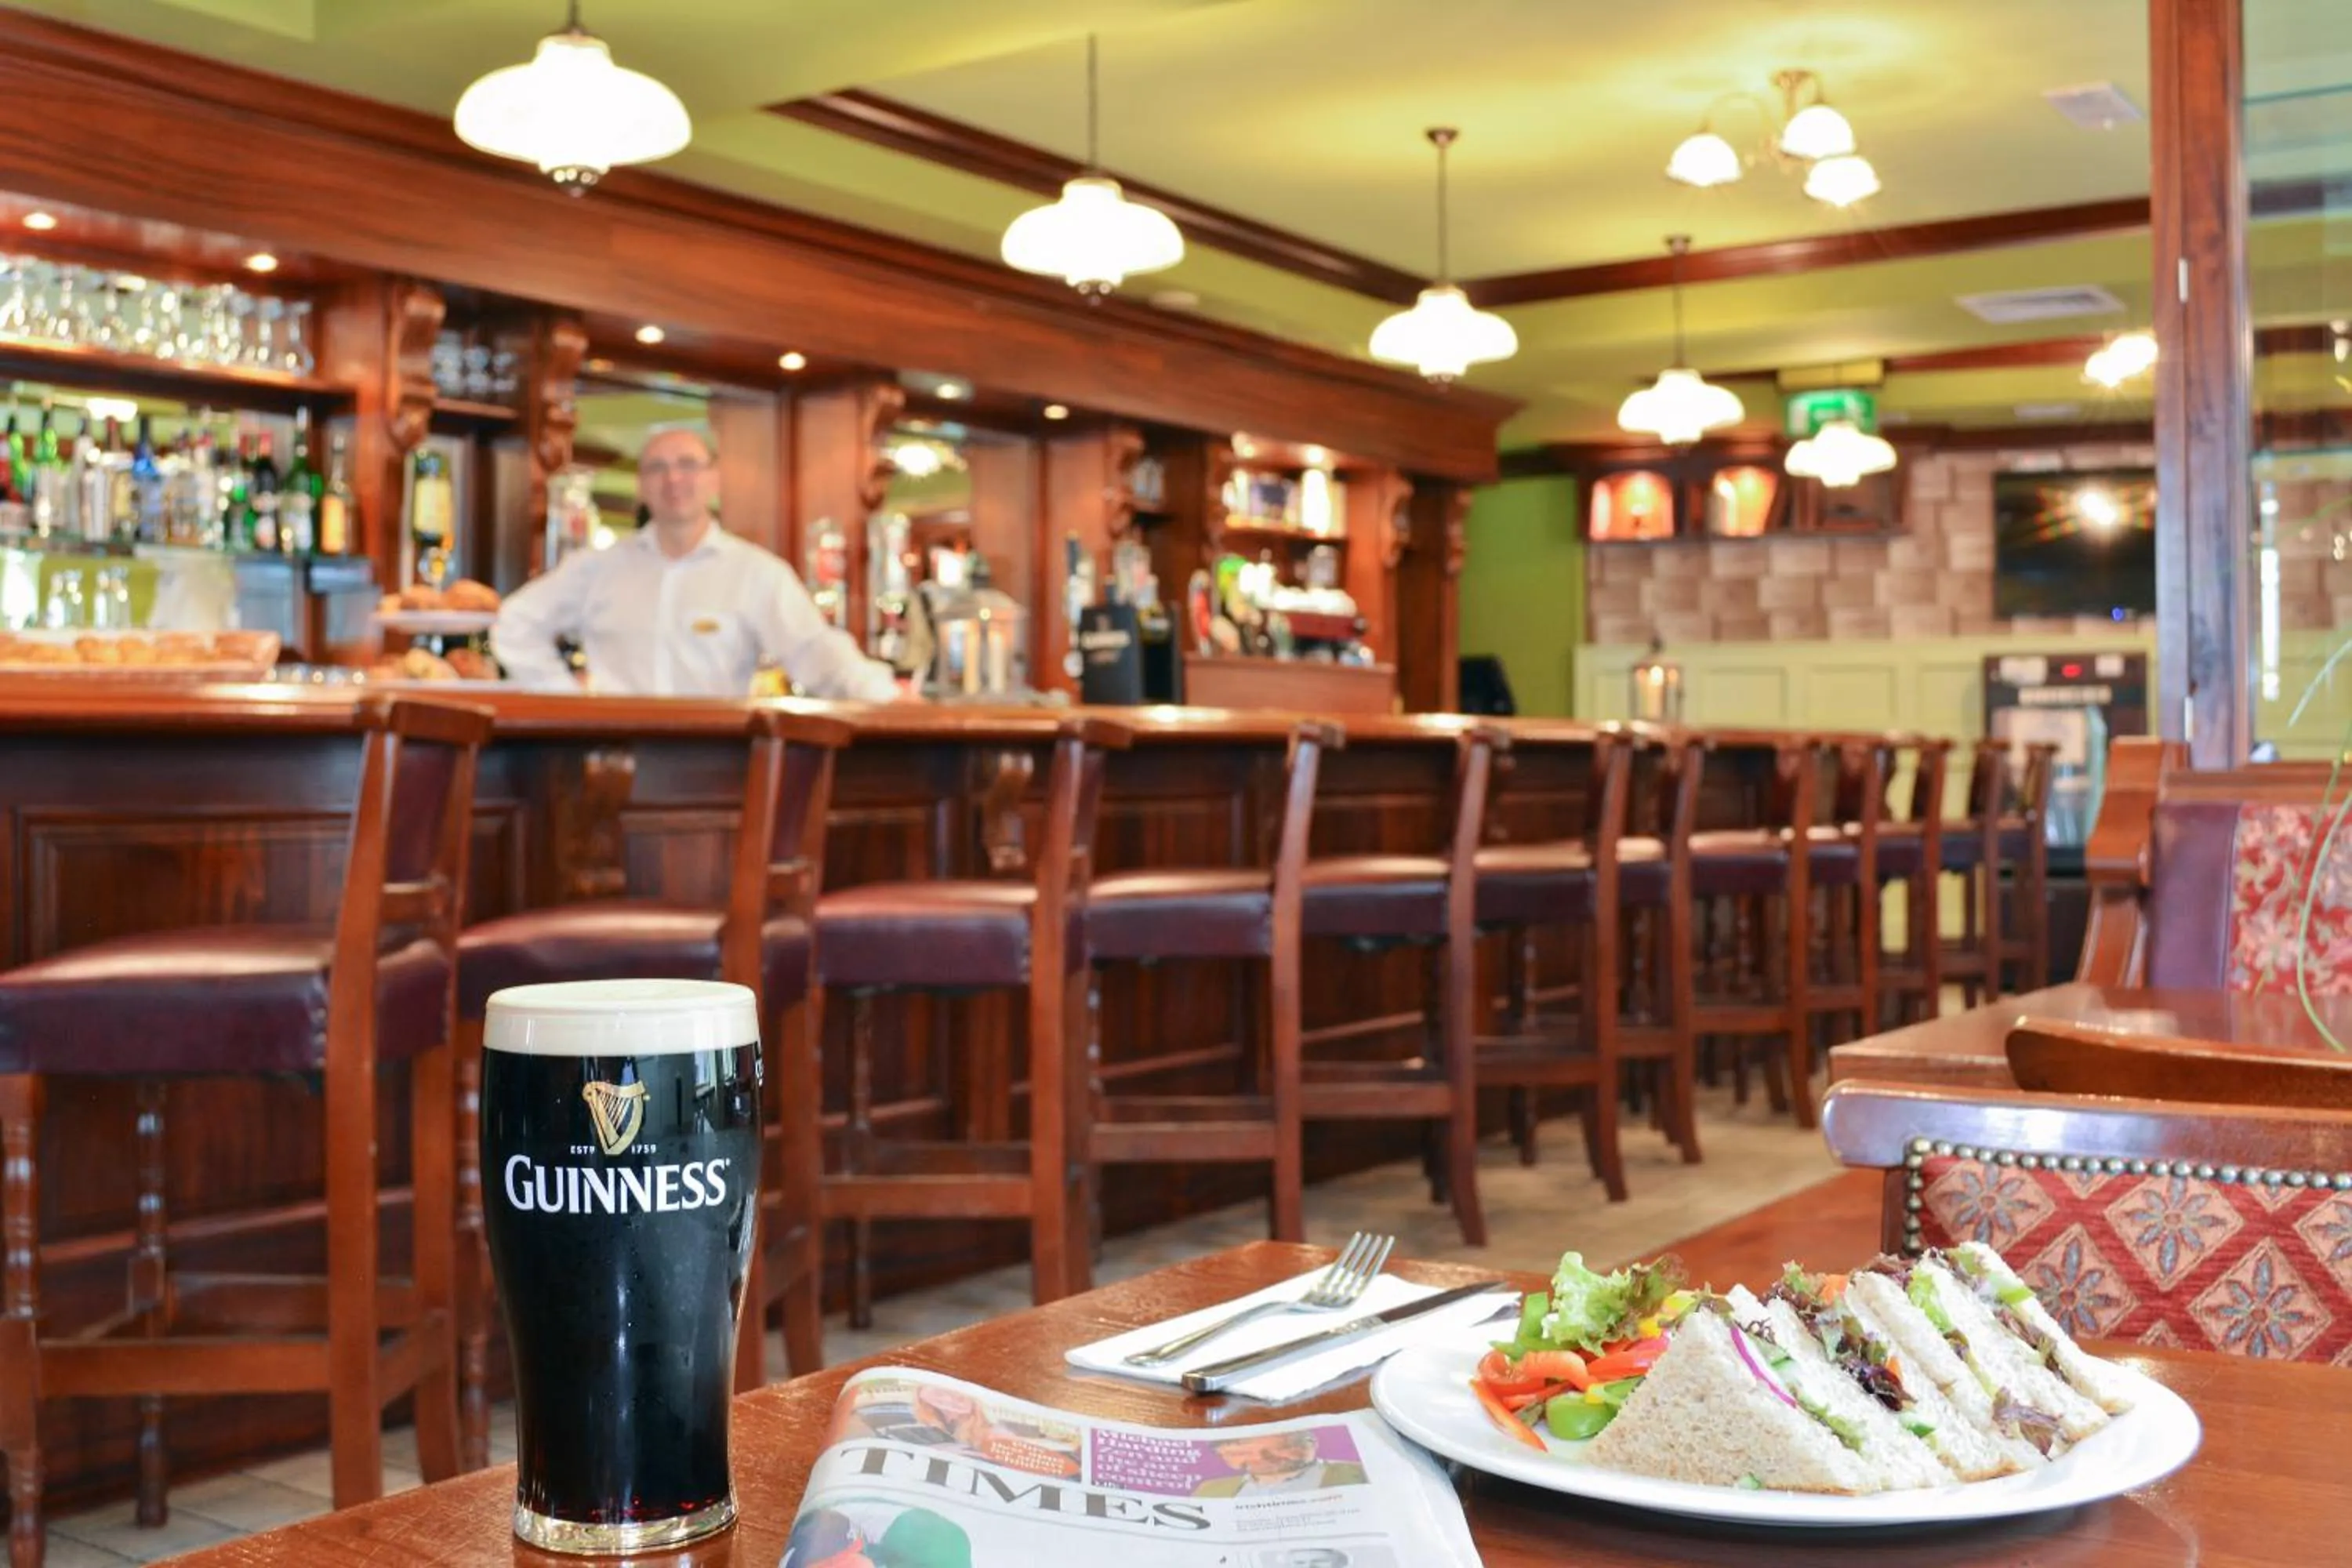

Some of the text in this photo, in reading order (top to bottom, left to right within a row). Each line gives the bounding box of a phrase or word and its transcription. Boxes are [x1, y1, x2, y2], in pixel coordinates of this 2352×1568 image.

[630, 1144, 657, 1155] 1759
[504, 1154, 728, 1214] GUINNESS
[1098, 1430, 1192, 1448] Michael
[840, 1446, 1211, 1530] TIMES
